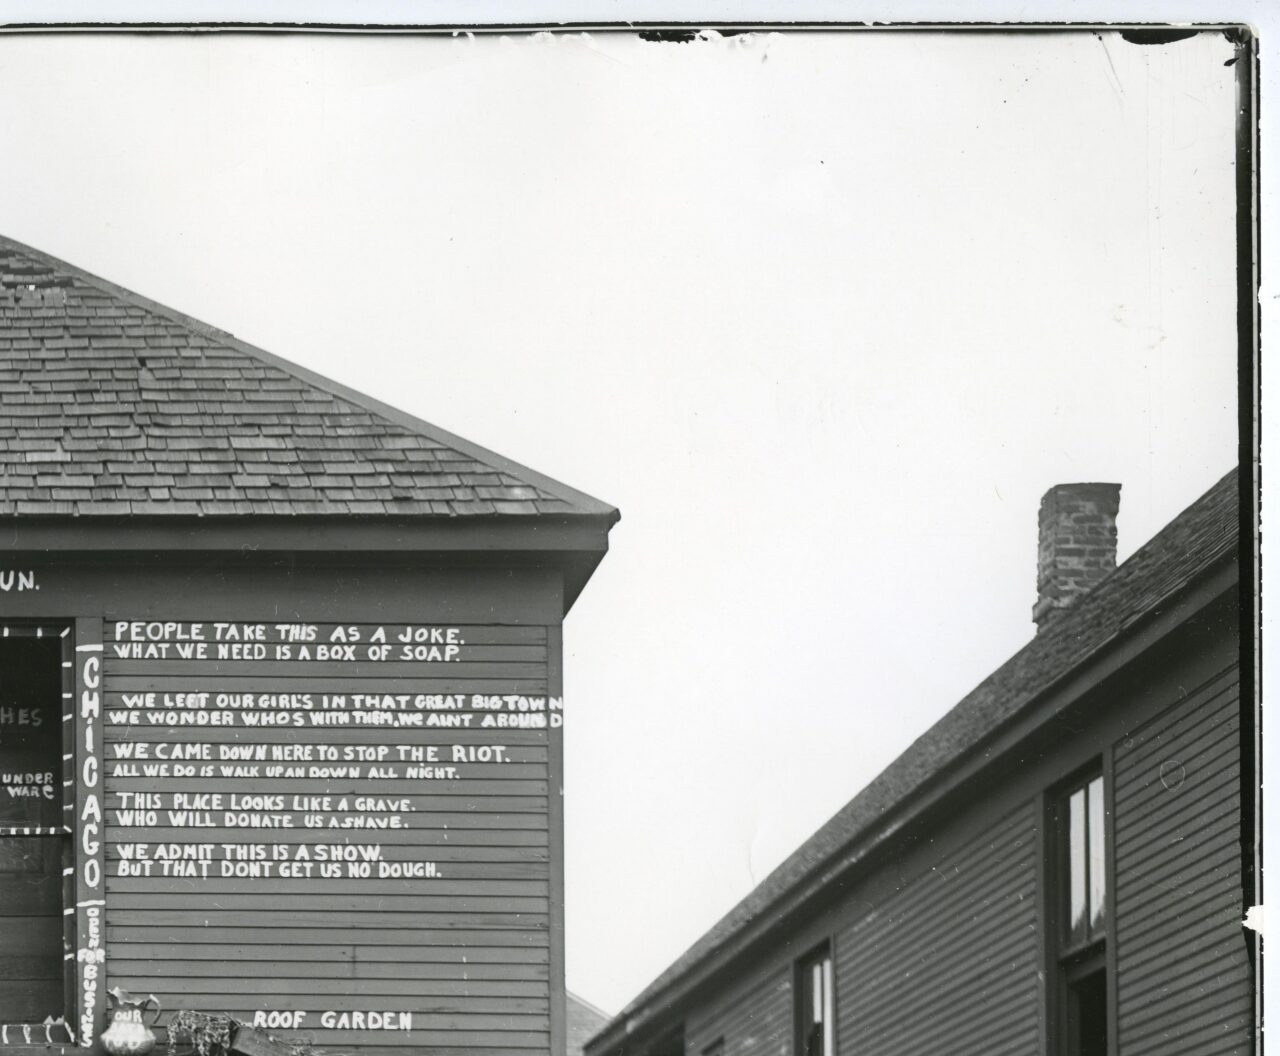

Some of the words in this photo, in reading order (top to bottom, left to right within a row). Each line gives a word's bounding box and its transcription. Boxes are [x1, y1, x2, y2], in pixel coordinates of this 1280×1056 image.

[116, 622, 204, 641] PEOPLE
[214, 623, 266, 640] TAKE
[275, 624, 318, 642] THIS
[330, 626, 360, 642] AS
[370, 627, 385, 643] A
[398, 627, 464, 644] JOKE.
[114, 643, 170, 658] WHAT
[176, 643, 207, 658] WE
[218, 644, 266, 659] NEED
[276, 645, 291, 659] IS
[299, 646, 310, 659] A
[317, 645, 356, 660] BOX
[368, 645, 392, 660] OF
[400, 645, 460, 661] SOAP.
[114, 743, 148, 758] WE
[155, 744, 211, 759] CAME
[220, 745, 267, 760] DOWN
[272, 745, 313, 760] HERE
[316, 746, 338, 760] TO
[344, 746, 389, 761] STOP
[396, 746, 438, 761] THE
[452, 745, 510, 762] RIOT.
[116, 792, 161, 809] THIS
[174, 794, 223, 809] PLACE
[231, 794, 284, 810] LOOKS
[293, 796, 331, 810] LIKE
[338, 798, 348, 810] A
[355, 797, 416, 811] GRAVE.
[117, 844, 148, 859] WE
[154, 844, 214, 859] ADMIT
[222, 845, 266, 860] THIS
[273, 845, 288, 860] IS
[295, 845, 309, 860] A
[314, 845, 383, 861] SHOW.
[252, 1011, 306, 1028] ROOF
[321, 1012, 412, 1030] GARDEN
